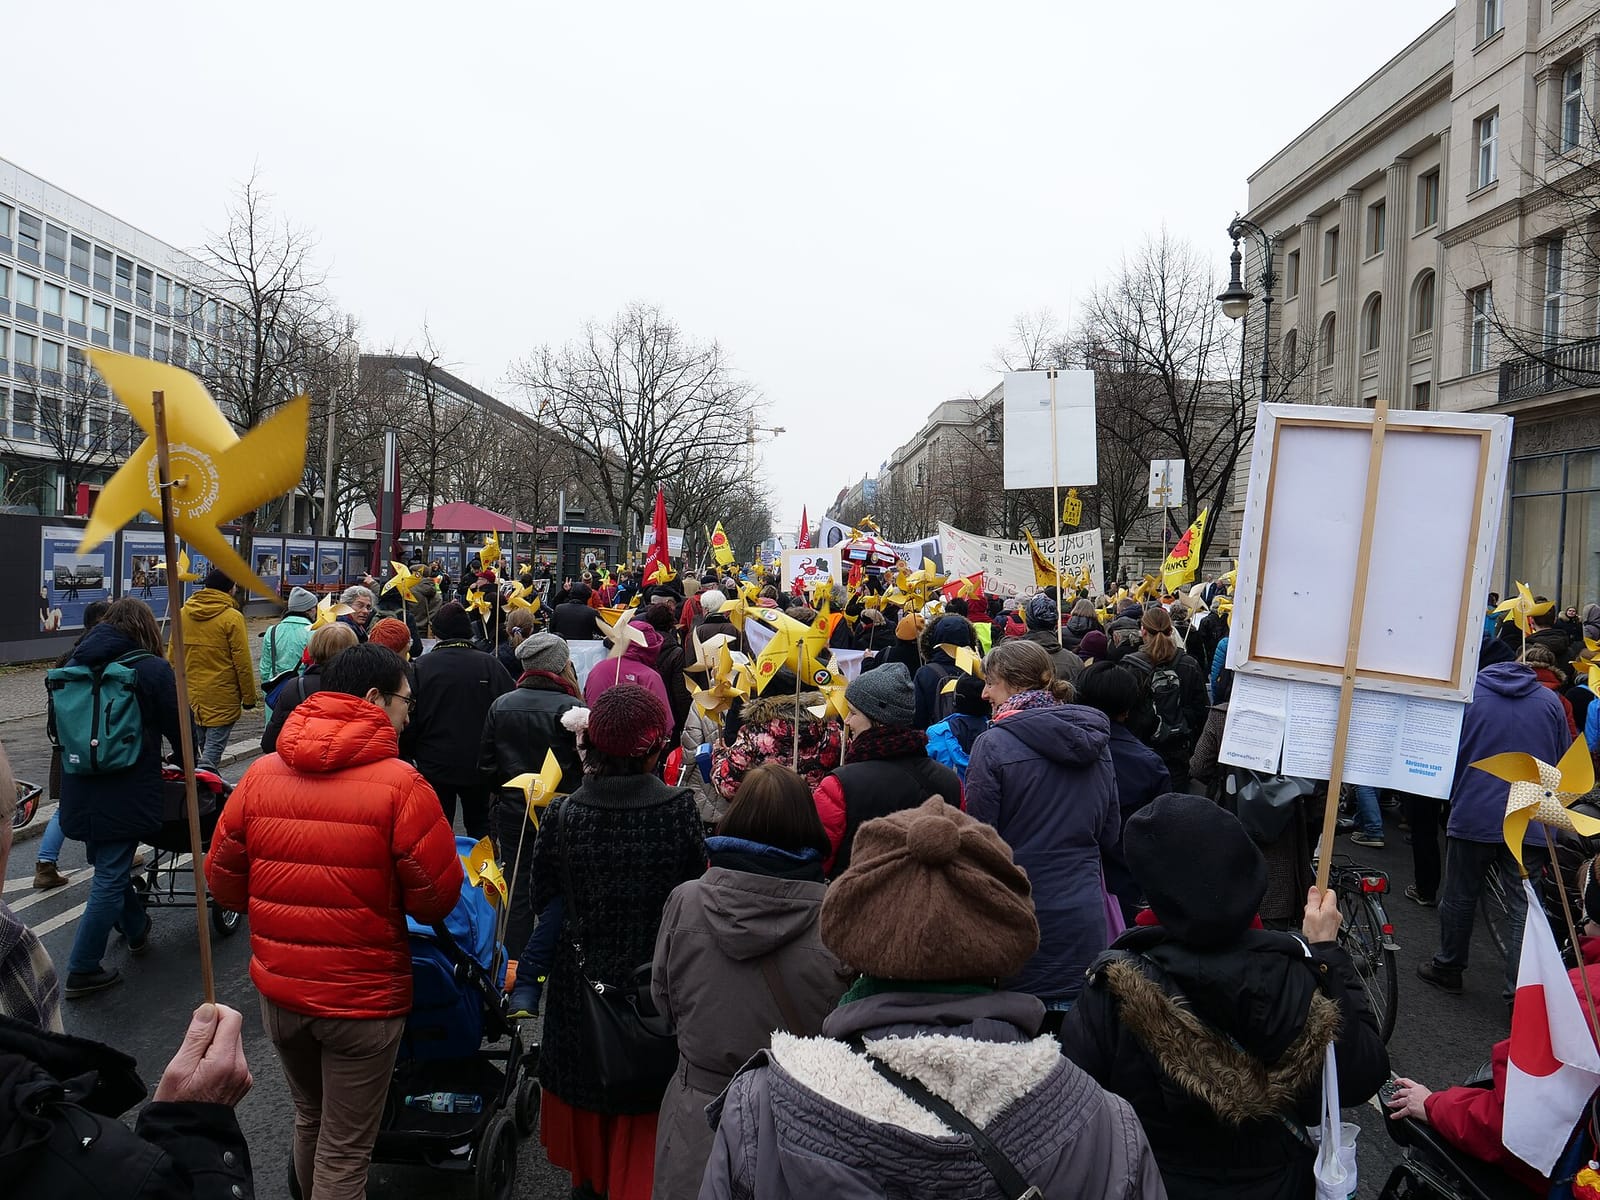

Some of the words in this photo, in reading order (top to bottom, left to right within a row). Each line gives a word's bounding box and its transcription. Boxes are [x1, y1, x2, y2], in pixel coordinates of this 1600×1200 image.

[188, 481, 220, 519] möglich!
[1405, 759, 1429, 769] Abrüsten
[1429, 764, 1443, 772] statt
